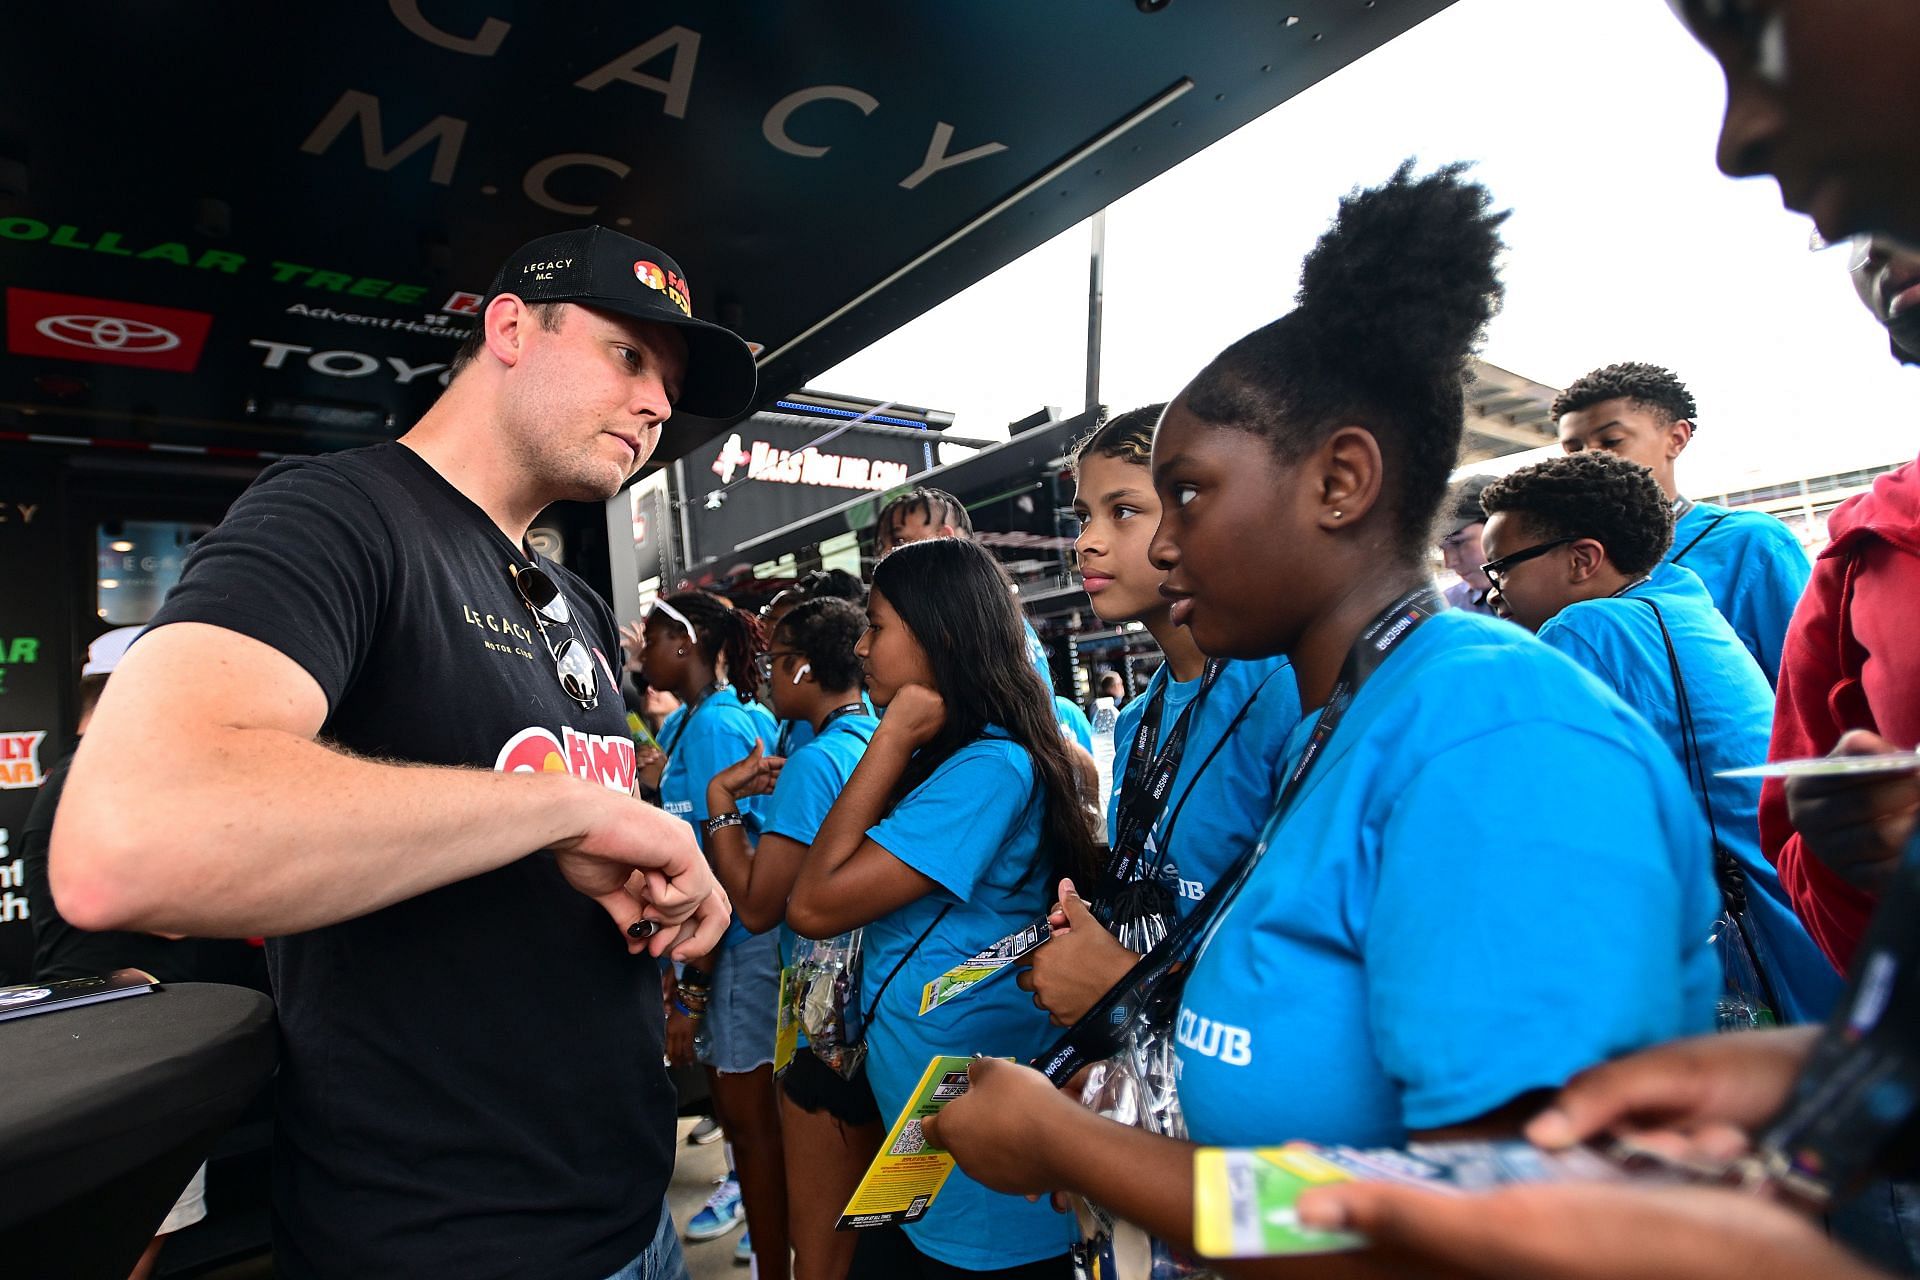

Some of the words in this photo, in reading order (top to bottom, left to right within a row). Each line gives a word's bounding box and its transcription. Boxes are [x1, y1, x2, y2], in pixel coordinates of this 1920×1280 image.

[0, 217, 246, 273] OLLAR
[272, 261, 429, 304] TREE
[523, 259, 573, 274] LEGACY
[535, 272, 554, 281] M.C.
[668, 286, 691, 318] DO
[285, 303, 472, 339] AdventHealt
[250, 339, 451, 386] TOY
[463, 604, 533, 645] LEGACY
[1363, 621, 1385, 640] PARTNER
[1374, 616, 1411, 651] NASCAR
[484, 640, 512, 654] MOTOR
[515, 647, 533, 660] CLUB
[1138, 725, 1150, 751] NASCAR
[1293, 742, 1317, 782] NASCAR
[1153, 771, 1170, 800] NASCAR
[664, 800, 693, 813] CLUB
[1177, 1007, 1252, 1066] CLUB
[1044, 1045, 1076, 1079] NASCAR
